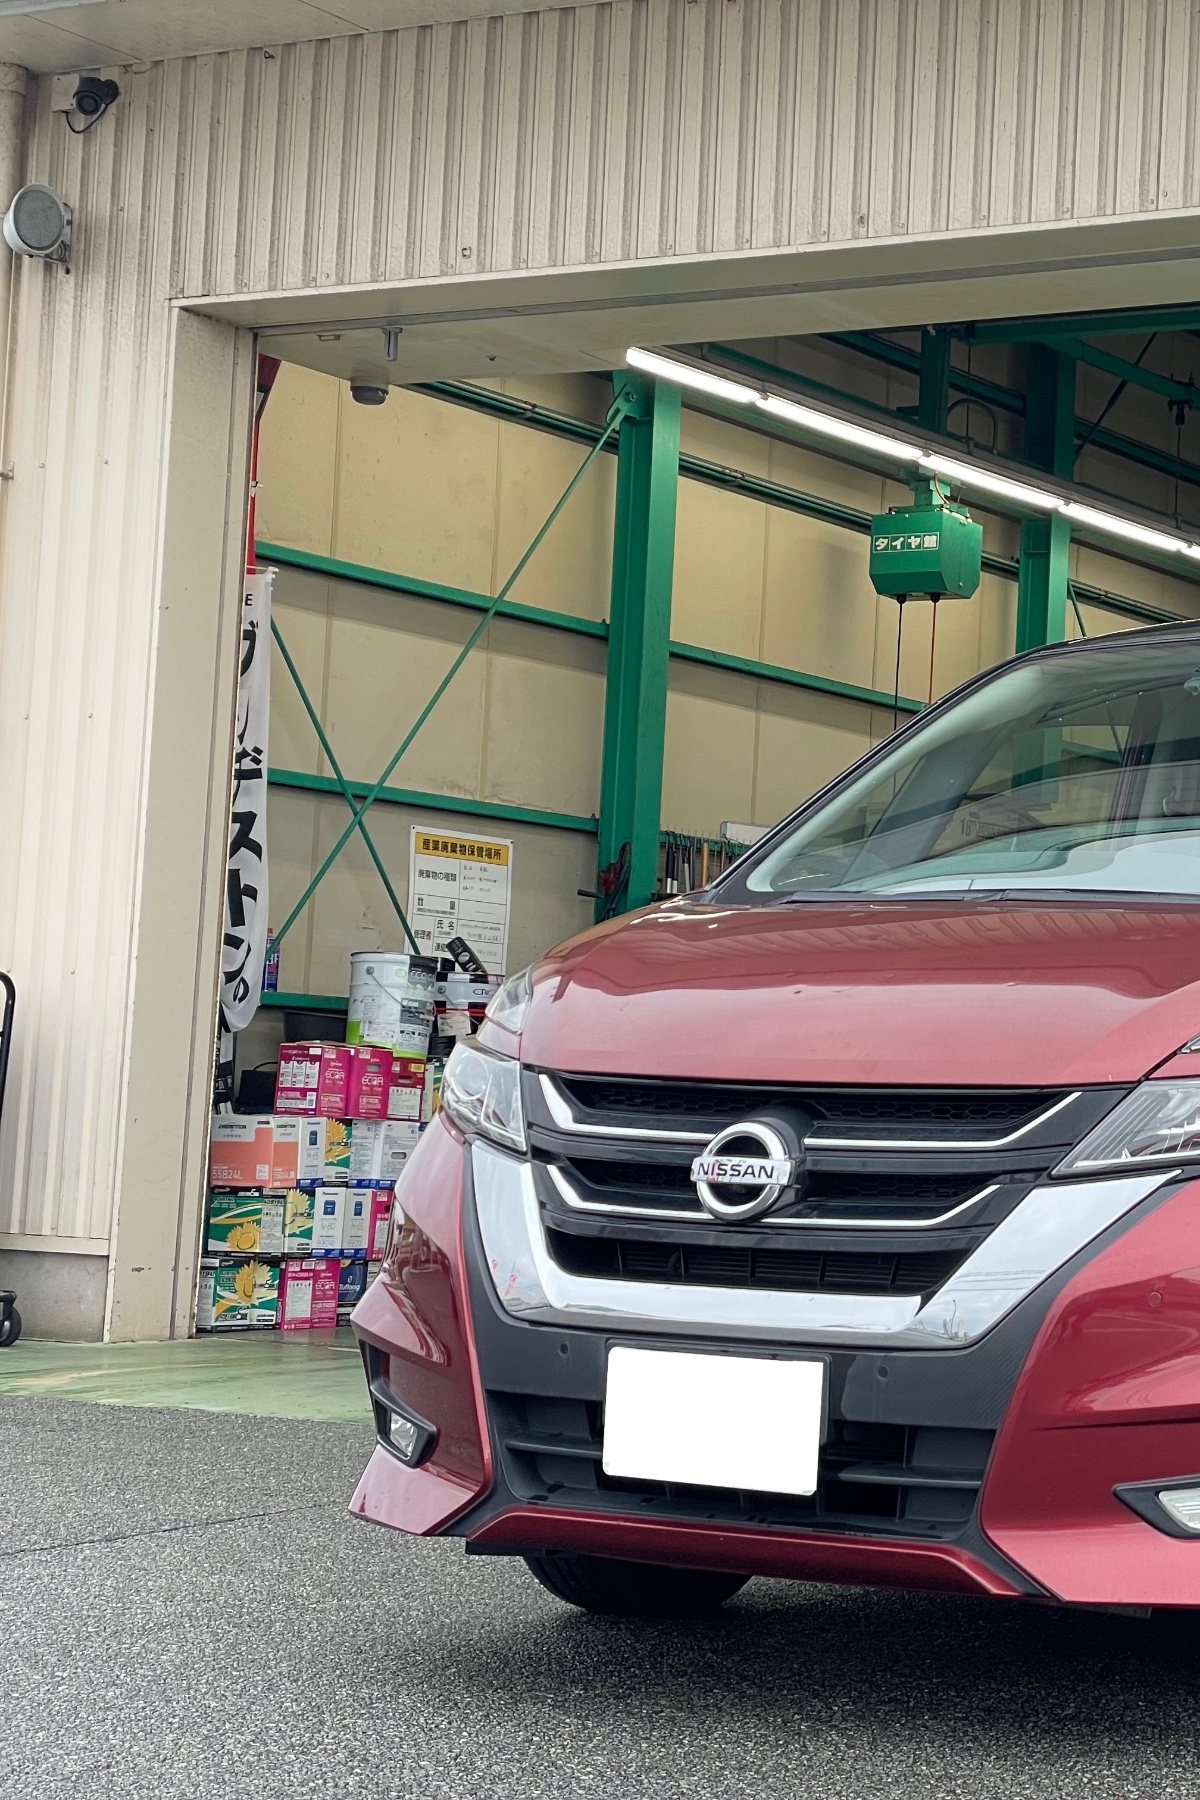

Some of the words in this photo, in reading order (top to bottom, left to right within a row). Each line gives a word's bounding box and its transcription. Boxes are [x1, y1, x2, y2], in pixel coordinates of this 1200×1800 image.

[875, 535, 938, 550] タイヤ館
[422, 838, 502, 861] 産業廃棄物保管場所
[212, 1169, 243, 1179] 55B24L
[697, 1162, 775, 1179] NISSAN
